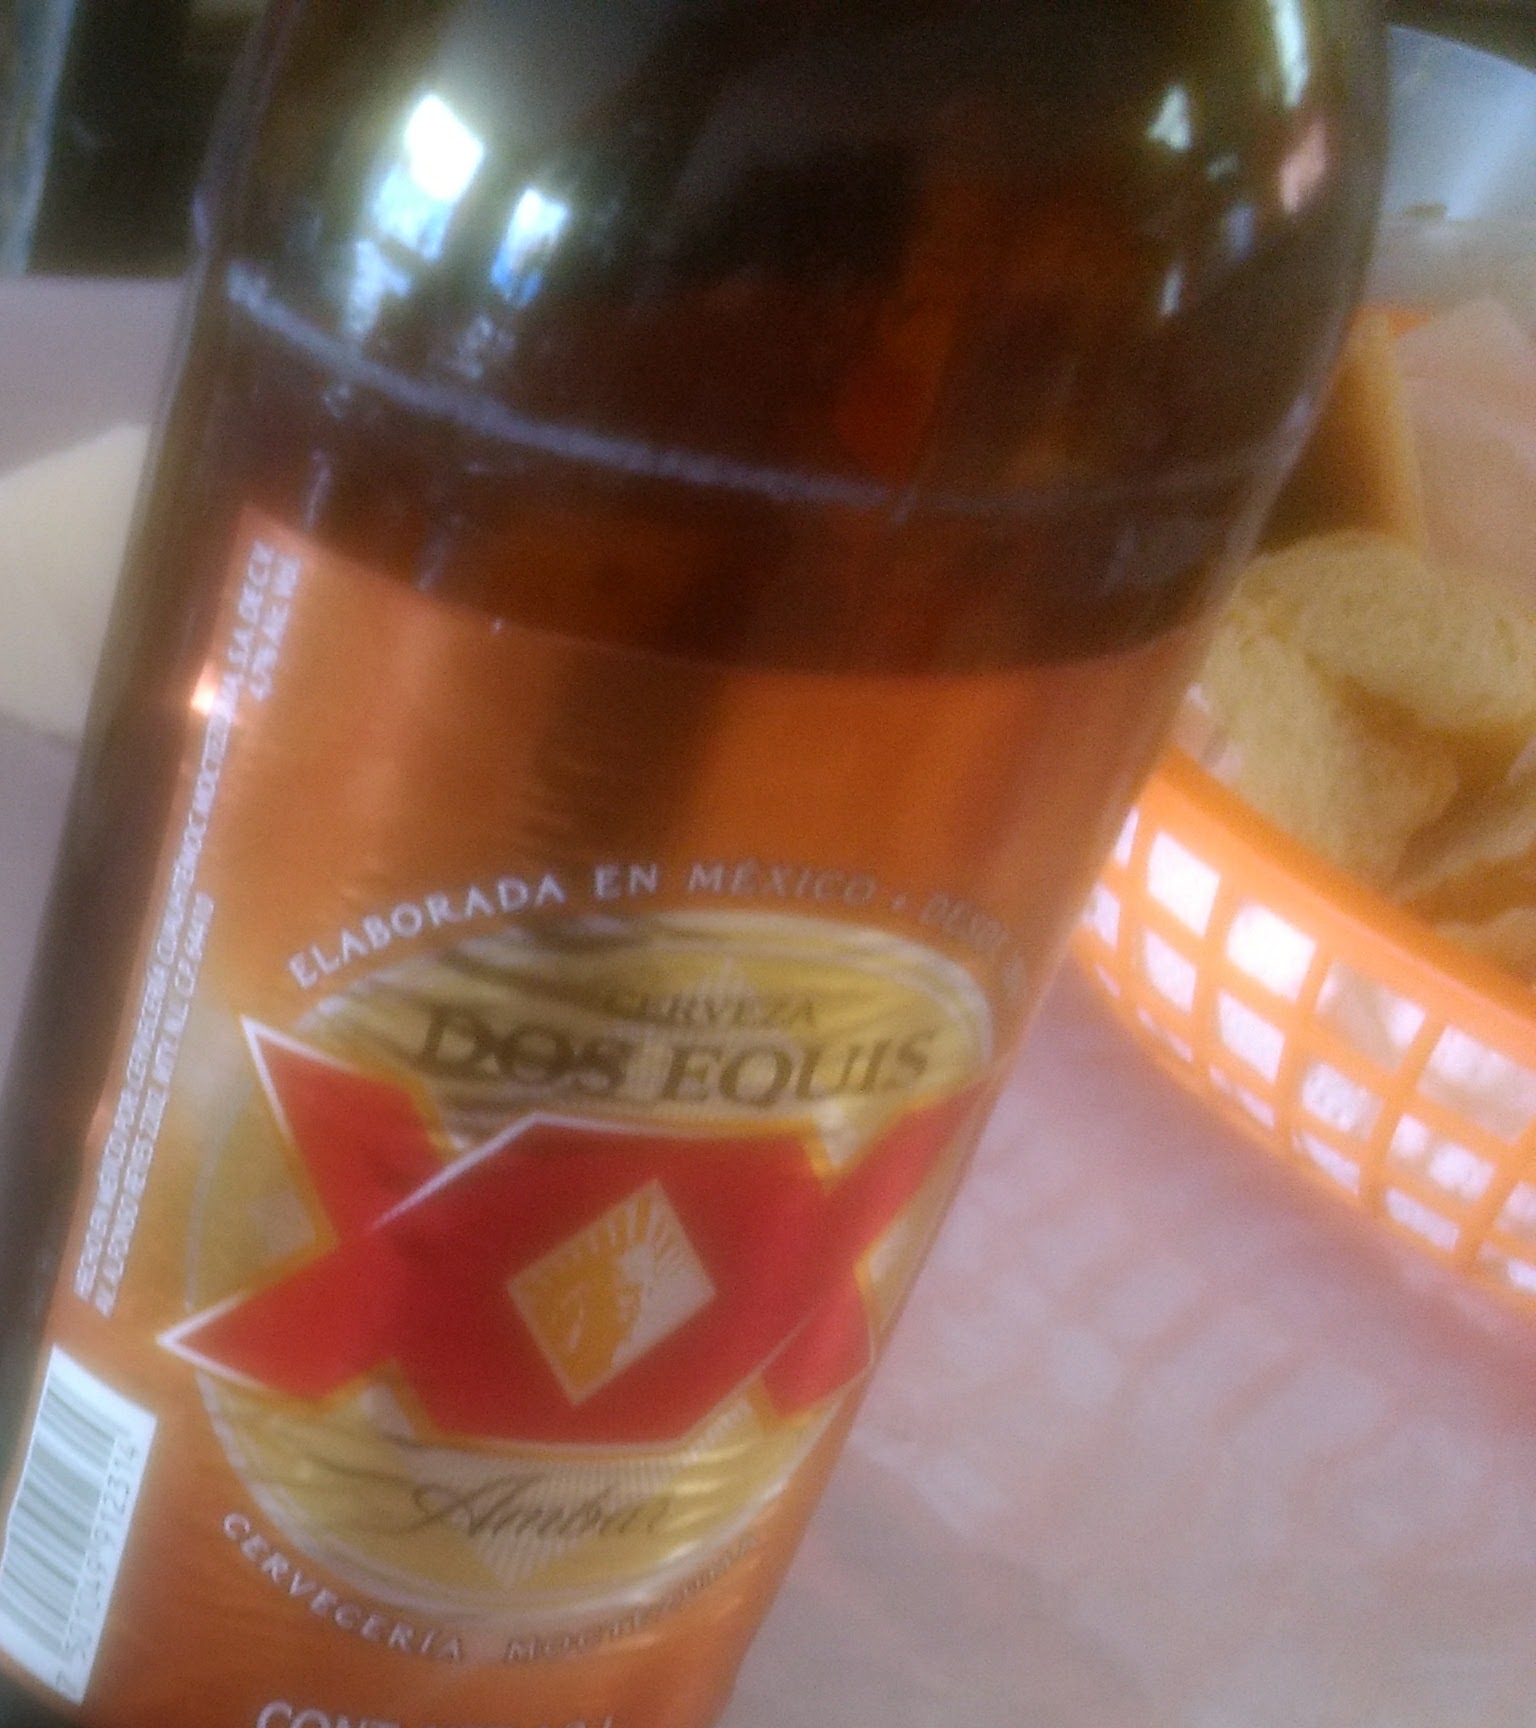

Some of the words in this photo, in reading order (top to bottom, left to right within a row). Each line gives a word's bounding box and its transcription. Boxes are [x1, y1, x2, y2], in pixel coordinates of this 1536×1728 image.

[285, 872, 567, 990] ELABORADA
[593, 863, 659, 899] EN
[423, 1006, 636, 1099] DOS
[656, 1028, 938, 1108] EQUIS
